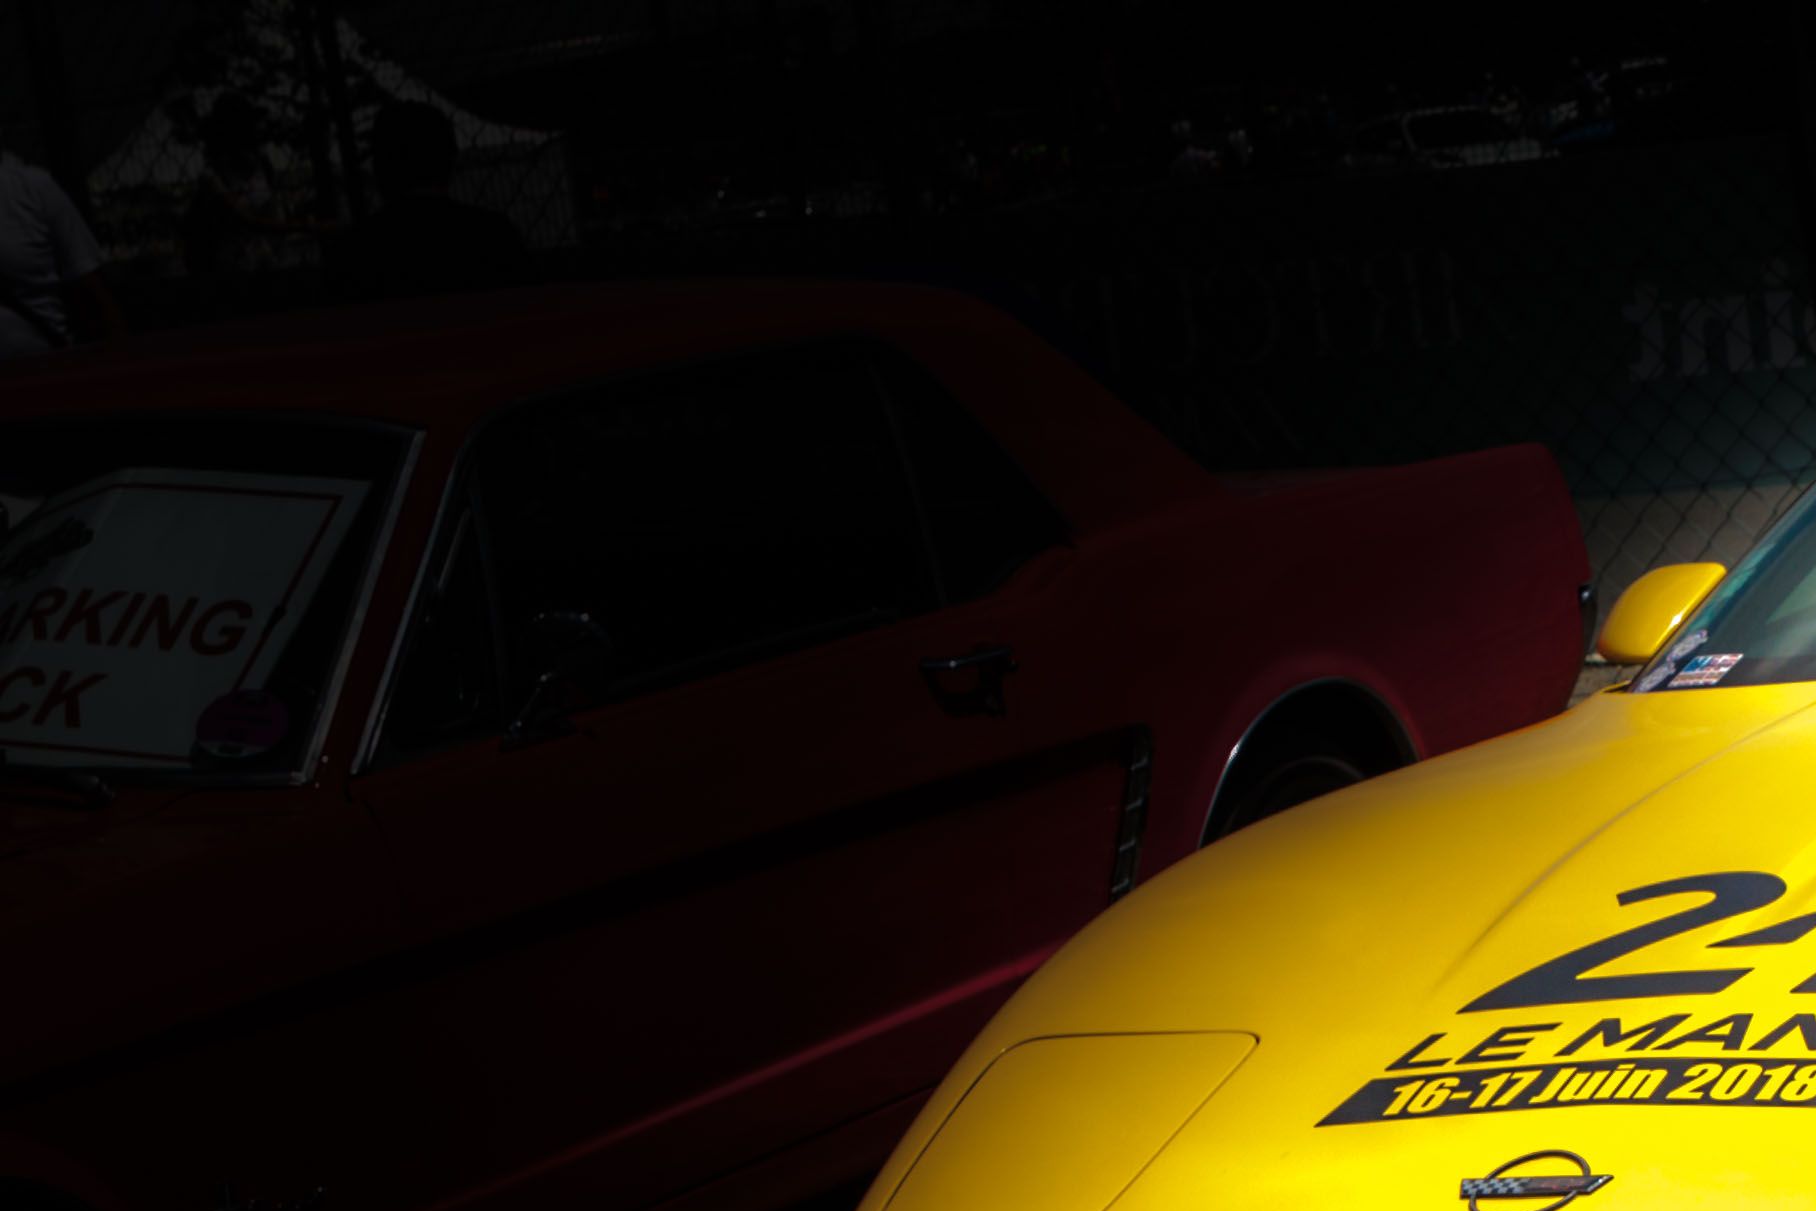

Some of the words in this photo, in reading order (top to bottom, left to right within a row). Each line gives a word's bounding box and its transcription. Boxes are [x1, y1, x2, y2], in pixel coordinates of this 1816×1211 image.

[1384, 1021, 1563, 1071] LE
[1382, 1068, 1543, 1117] 16-17
[1529, 1063, 1669, 1105] Juin
